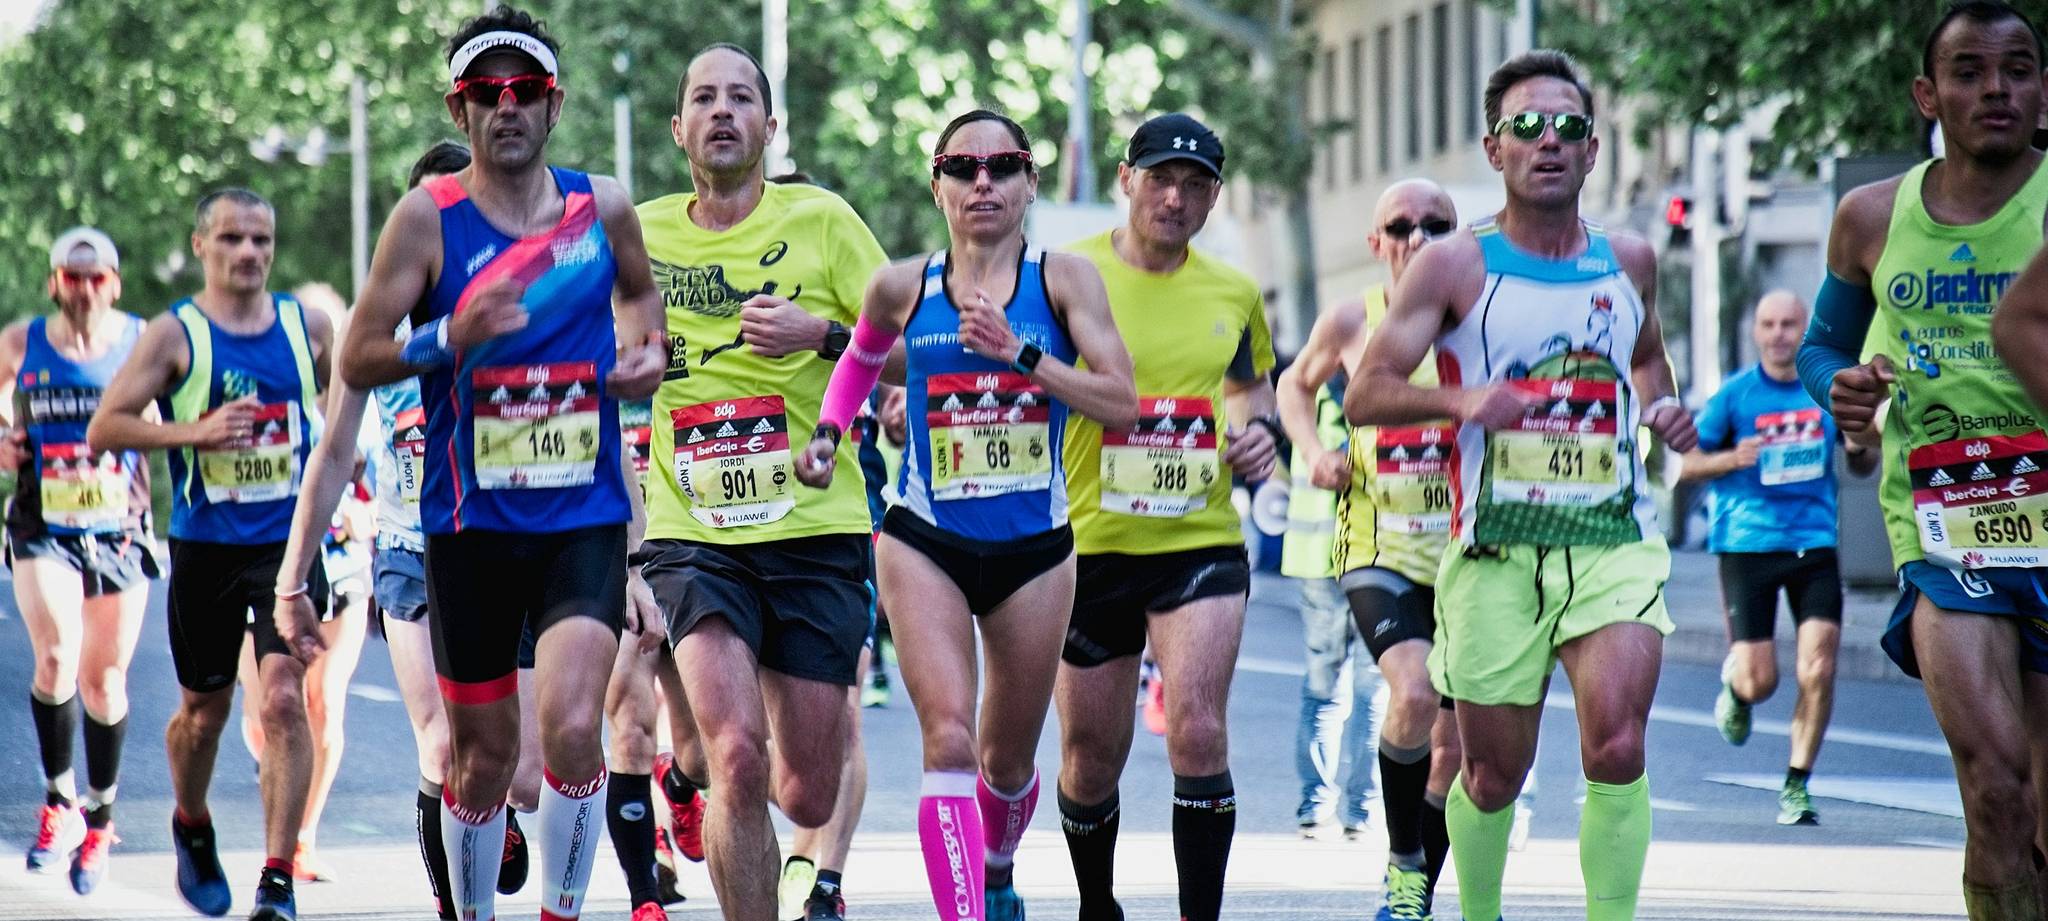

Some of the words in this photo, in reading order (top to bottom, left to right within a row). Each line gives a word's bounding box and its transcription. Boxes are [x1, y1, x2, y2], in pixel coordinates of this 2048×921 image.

[663, 287, 727, 307] MAD
[976, 373, 999, 391] edp
[714, 402, 736, 419] edp
[1960, 411, 2036, 431] Banplus
[973, 426, 1009, 438] TAMARA
[528, 427, 565, 457] 146
[1965, 441, 1991, 458] edp
[720, 457, 744, 468] JORDI
[952, 442, 964, 472] F
[986, 440, 1010, 468] 68
[1549, 447, 1583, 476] 431
[234, 458, 272, 481] 5280
[1153, 463, 1186, 491] 388
[1971, 472, 1996, 480] adidas
[2012, 466, 2040, 475] adidas
[722, 468, 756, 500] 901
[1929, 478, 1955, 487] adidas
[728, 511, 768, 523] HUAWEI
[1969, 501, 2017, 517] ZANCUDO
[1974, 514, 2032, 543] 6590
[1989, 556, 2039, 564] HUAWEI
[563, 801, 589, 891] COMPRESSPORT
